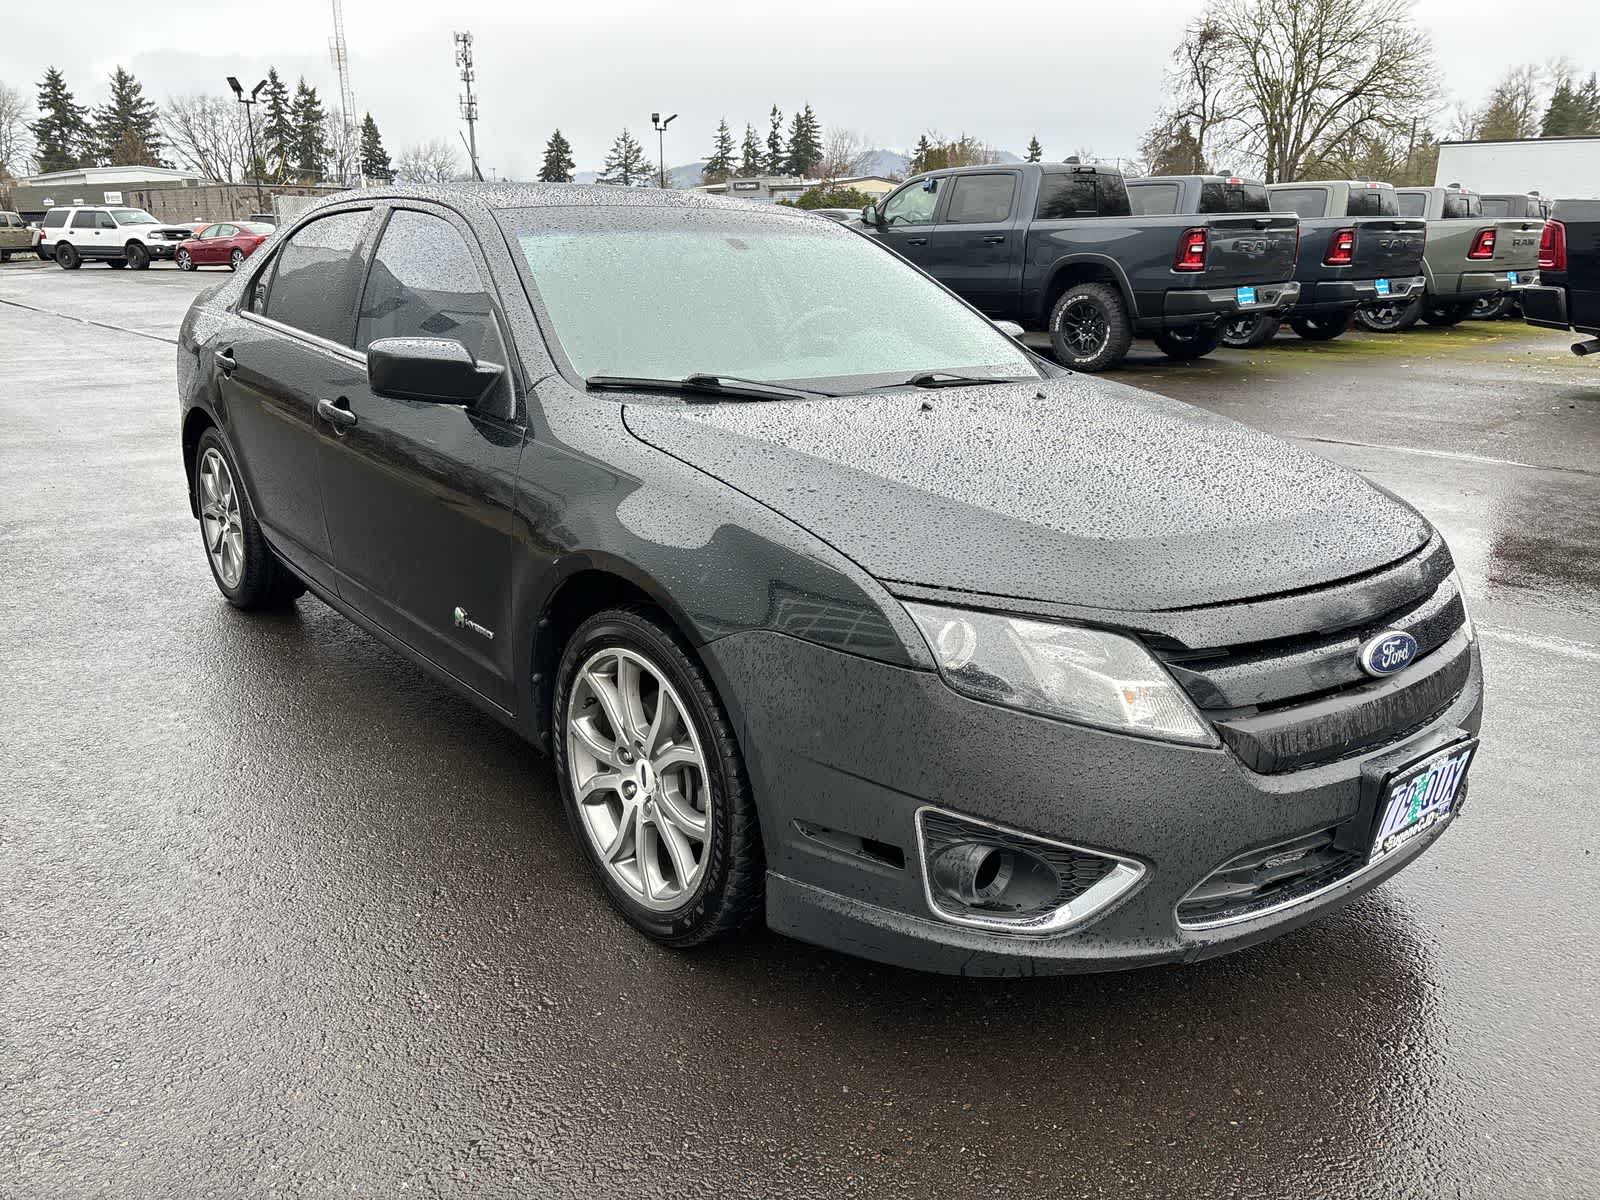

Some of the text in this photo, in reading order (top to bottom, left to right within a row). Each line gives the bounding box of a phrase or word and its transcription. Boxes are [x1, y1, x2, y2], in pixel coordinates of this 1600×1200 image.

[1239, 239, 1279, 251] RAM
[1512, 238, 1535, 247] RAM
[1382, 639, 1408, 668] Ford
[1378, 758, 1466, 838] 779 QUX
